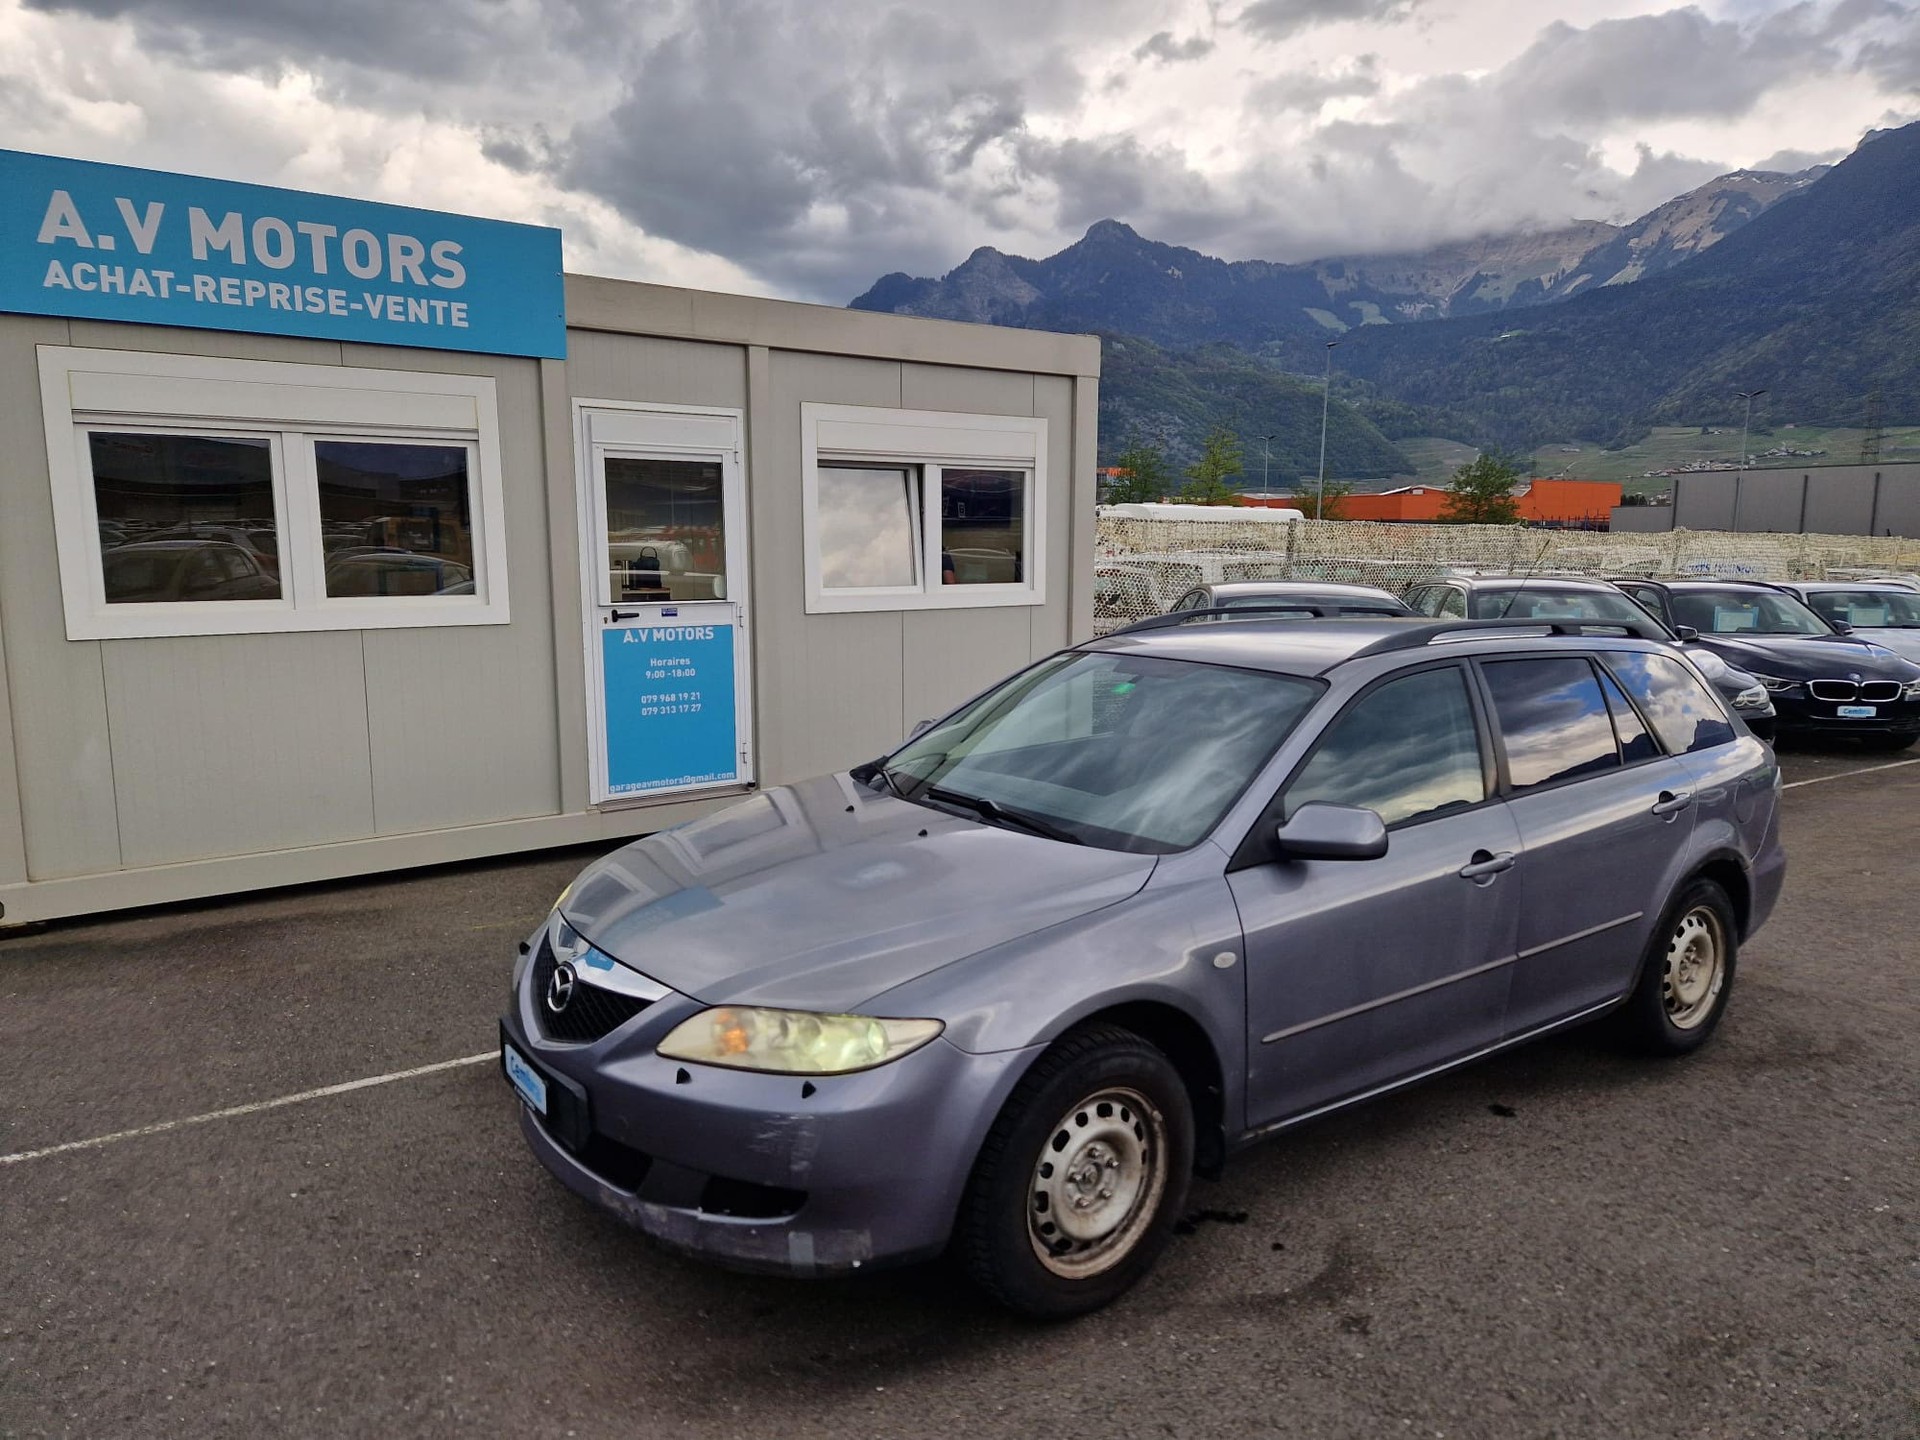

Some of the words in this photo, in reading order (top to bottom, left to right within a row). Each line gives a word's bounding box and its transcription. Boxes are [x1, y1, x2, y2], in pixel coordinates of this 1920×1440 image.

[36, 189, 165, 254] A.V
[188, 206, 467, 289] MOTORS
[43, 259, 469, 328] ACHAT-REPRISE-VENTE
[623, 629, 649, 643] A.V
[653, 626, 715, 642] MOTORS
[650, 657, 691, 667] Horaires
[641, 694, 658, 704] 079
[659, 693, 676, 703] 968
[678, 692, 689, 701] 19
[690, 691, 701, 701] 21
[641, 706, 658, 716] 079
[660, 705, 677, 714] 313
[678, 704, 689, 713] 17
[690, 703, 702, 712] 27
